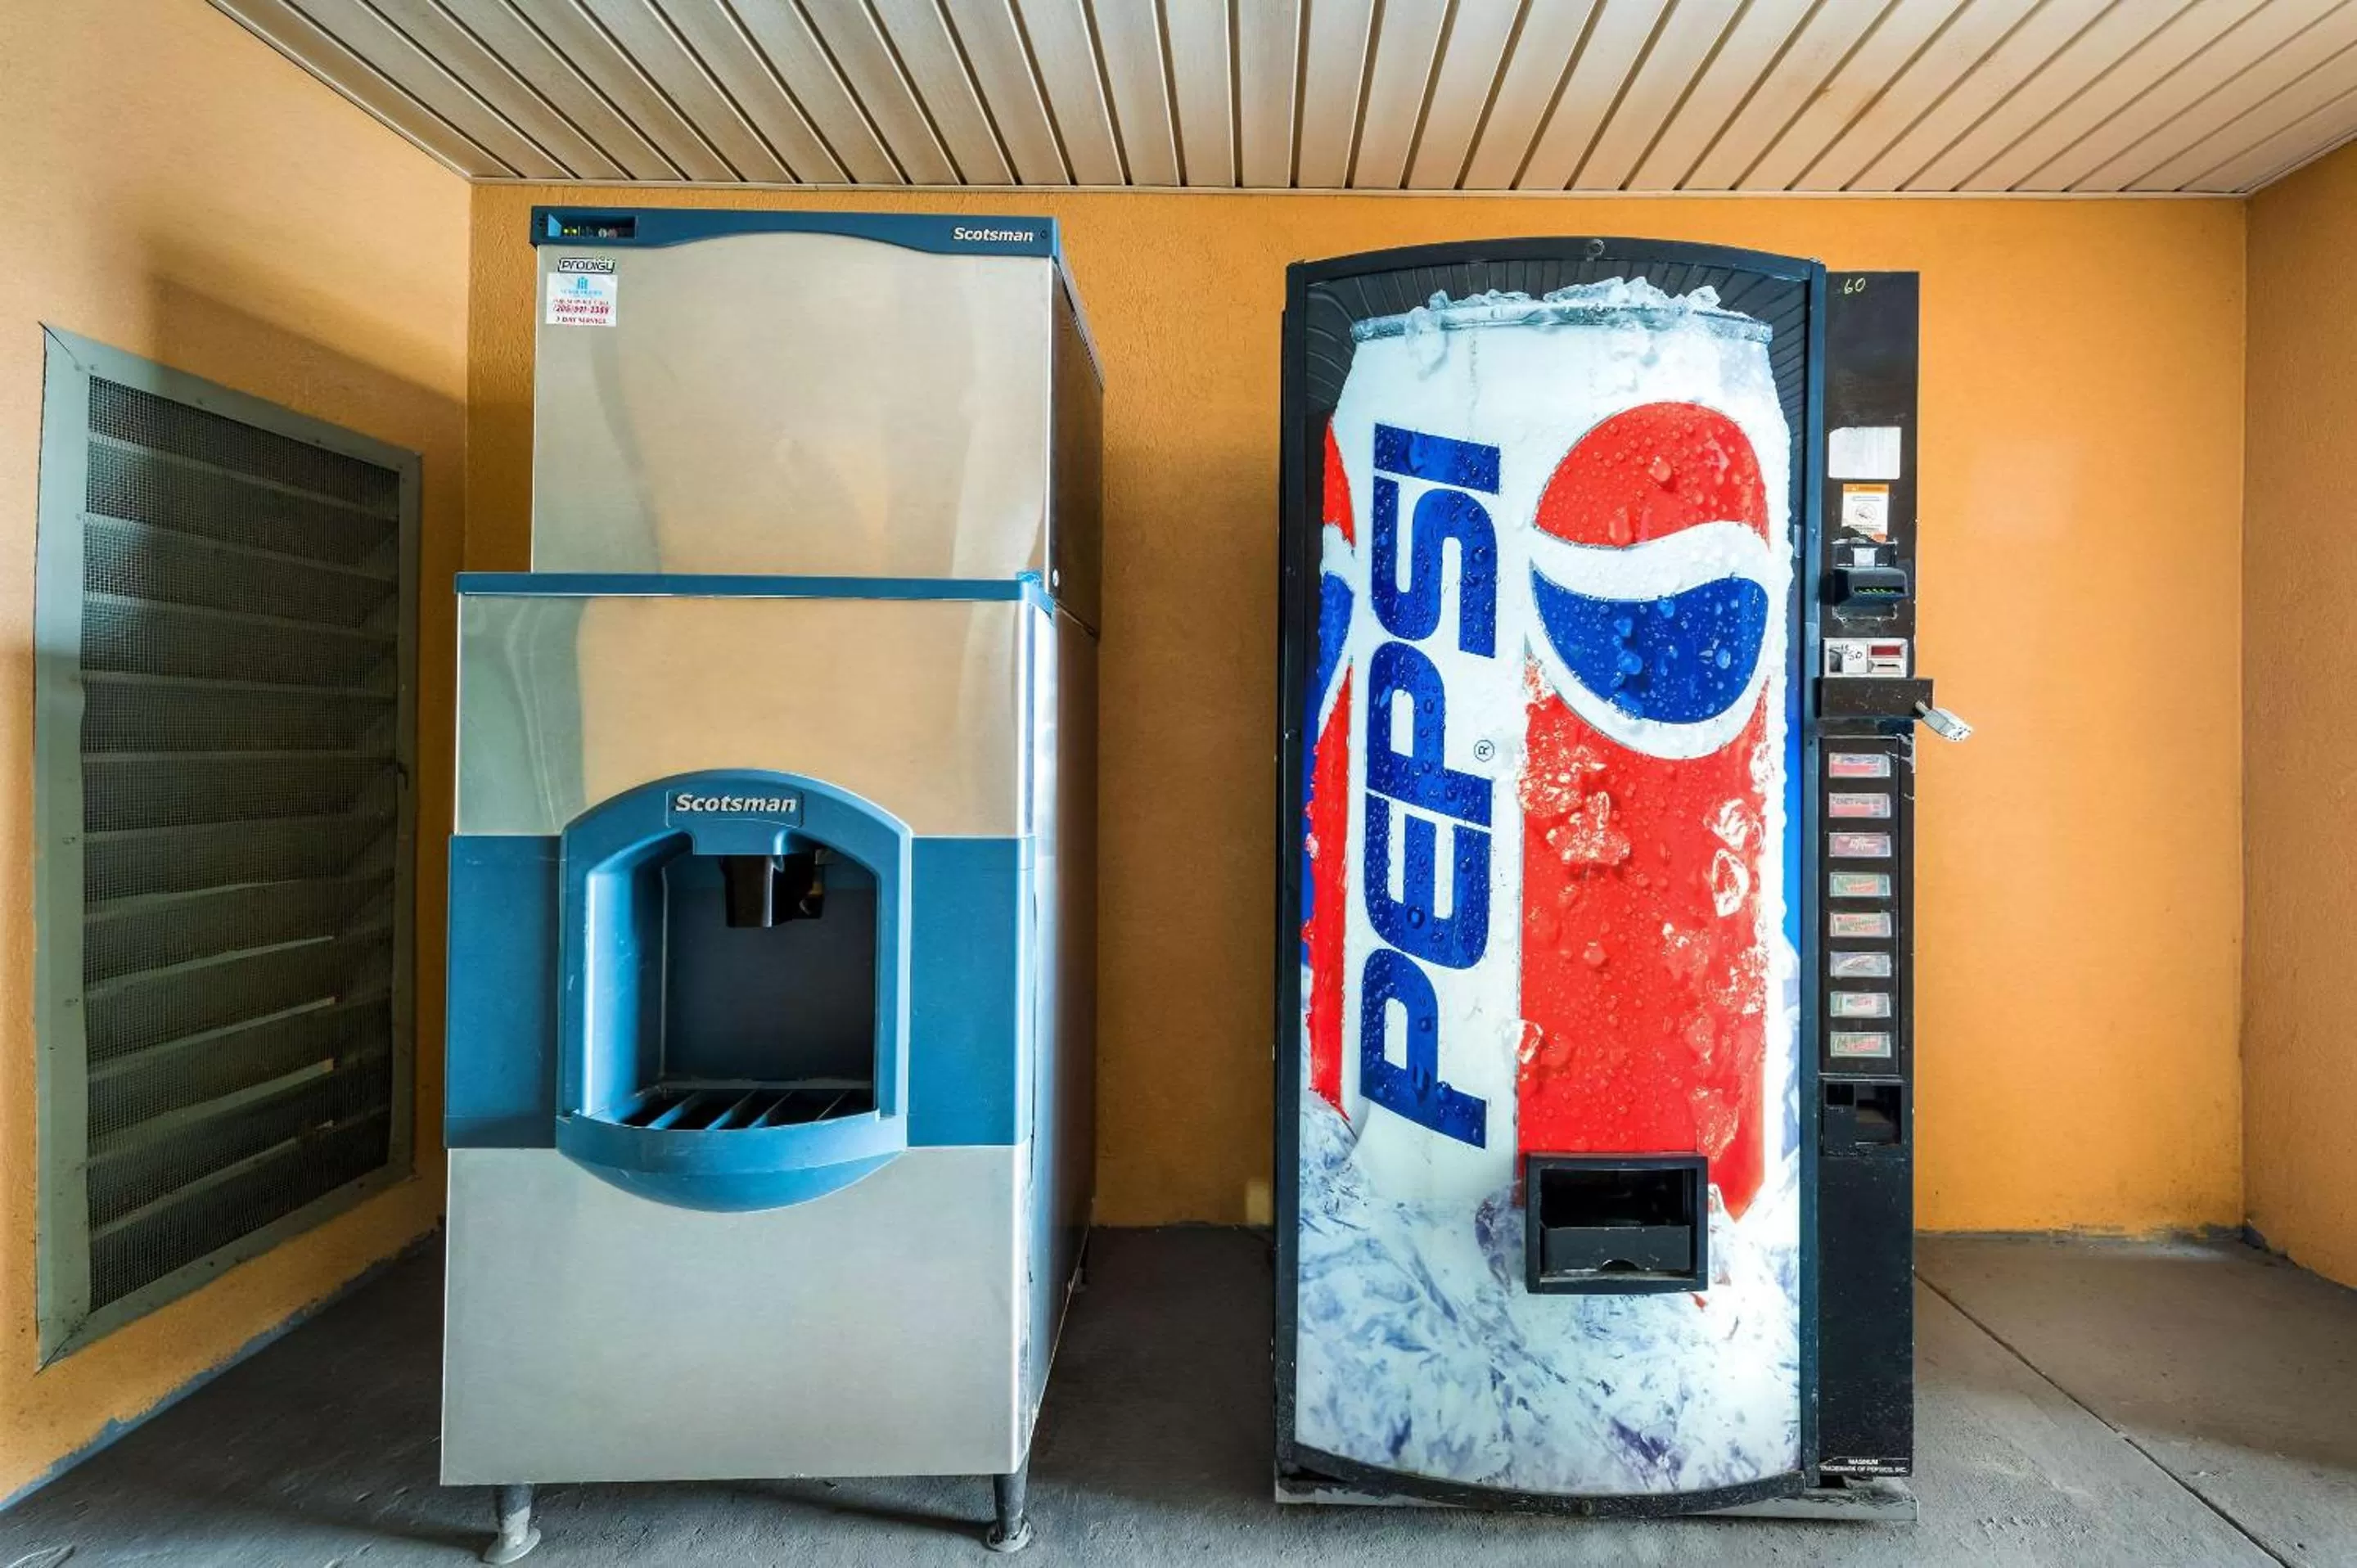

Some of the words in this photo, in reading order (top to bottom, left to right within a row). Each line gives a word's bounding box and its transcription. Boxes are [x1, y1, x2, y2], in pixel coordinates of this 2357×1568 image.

[953, 227, 1034, 243] Scotsman
[1844, 277, 1866, 295] 60
[1359, 421, 1501, 1150] PEPSI
[674, 793, 797, 813] Scotsman
